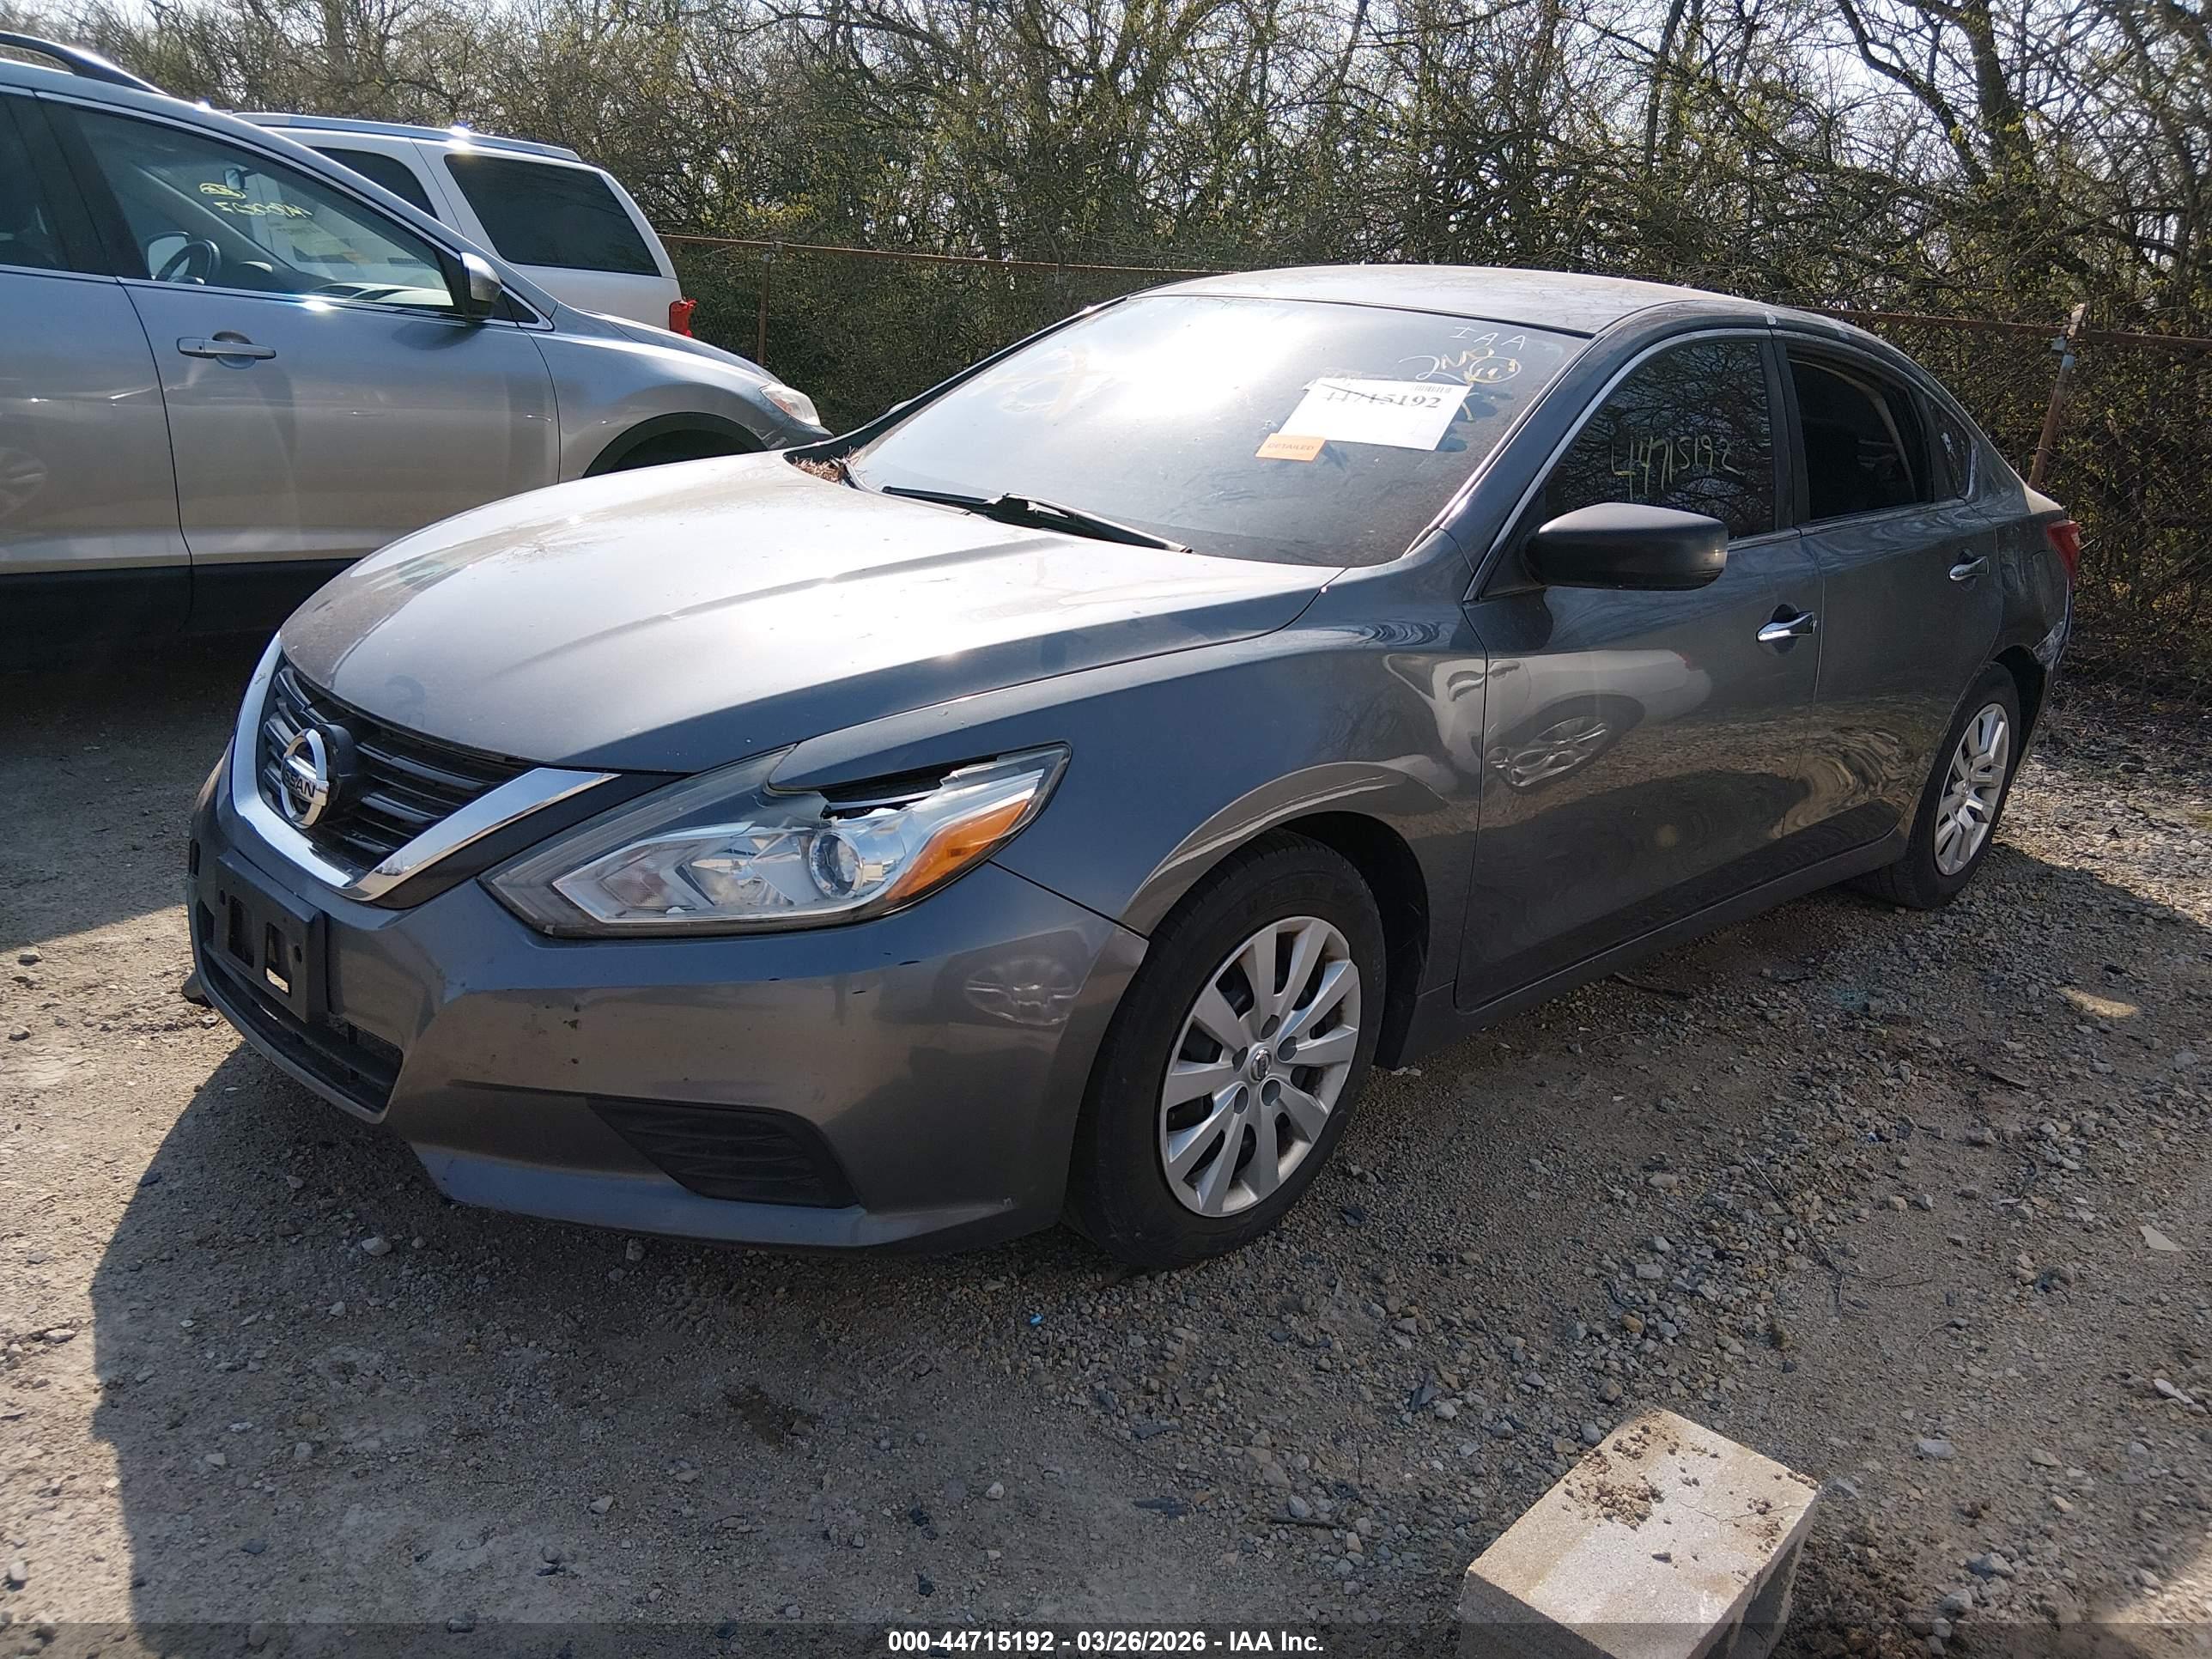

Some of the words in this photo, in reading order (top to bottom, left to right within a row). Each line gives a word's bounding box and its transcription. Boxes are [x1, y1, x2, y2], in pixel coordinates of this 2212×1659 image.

[1449, 325, 1526, 350] IAA
[1267, 441, 1315, 452] DETAILED
[283, 768, 316, 798] SSAN
